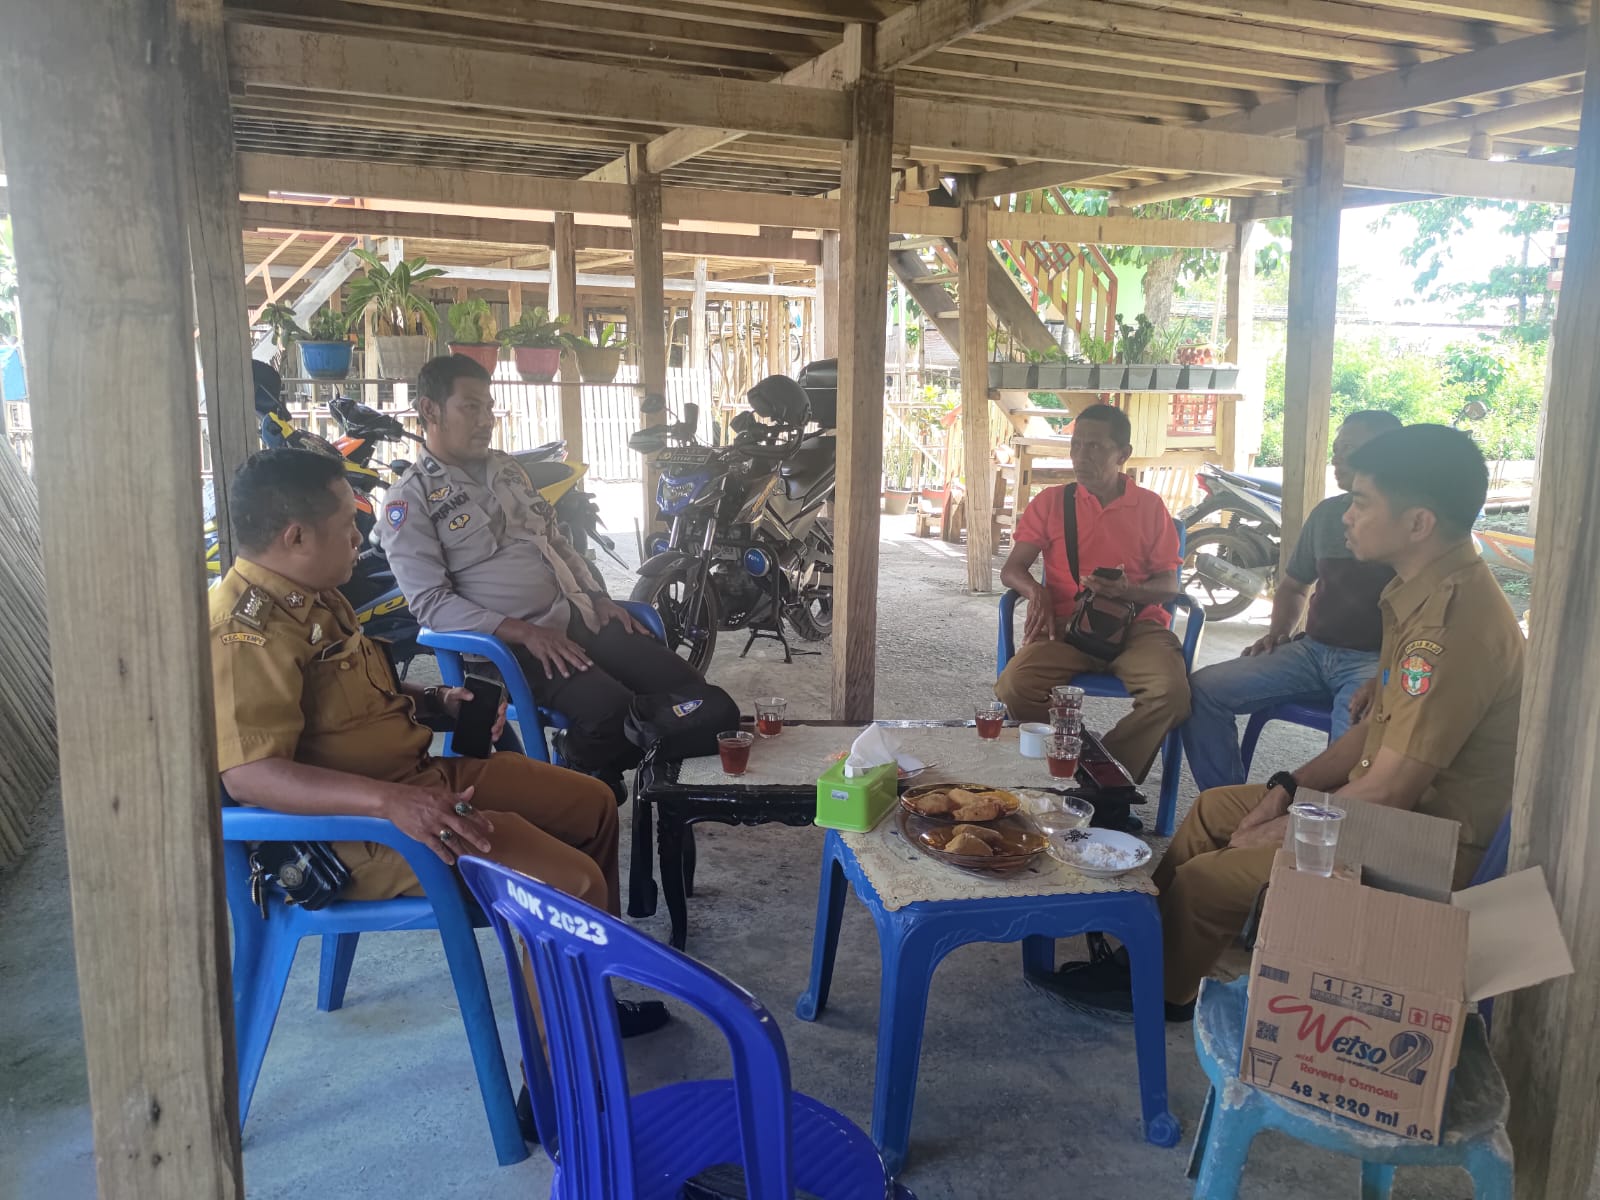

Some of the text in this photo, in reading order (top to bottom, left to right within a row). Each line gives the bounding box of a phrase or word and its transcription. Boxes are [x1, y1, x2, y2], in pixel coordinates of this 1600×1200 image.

[547, 905, 608, 946] 2023
[1323, 978, 1393, 1007] 1 2 3
[1291, 1080, 1313, 1098] 48
[1335, 1094, 1370, 1117] 220
[1375, 1107, 1400, 1128] ml
[1349, 1077, 1399, 1101] Osmosis
